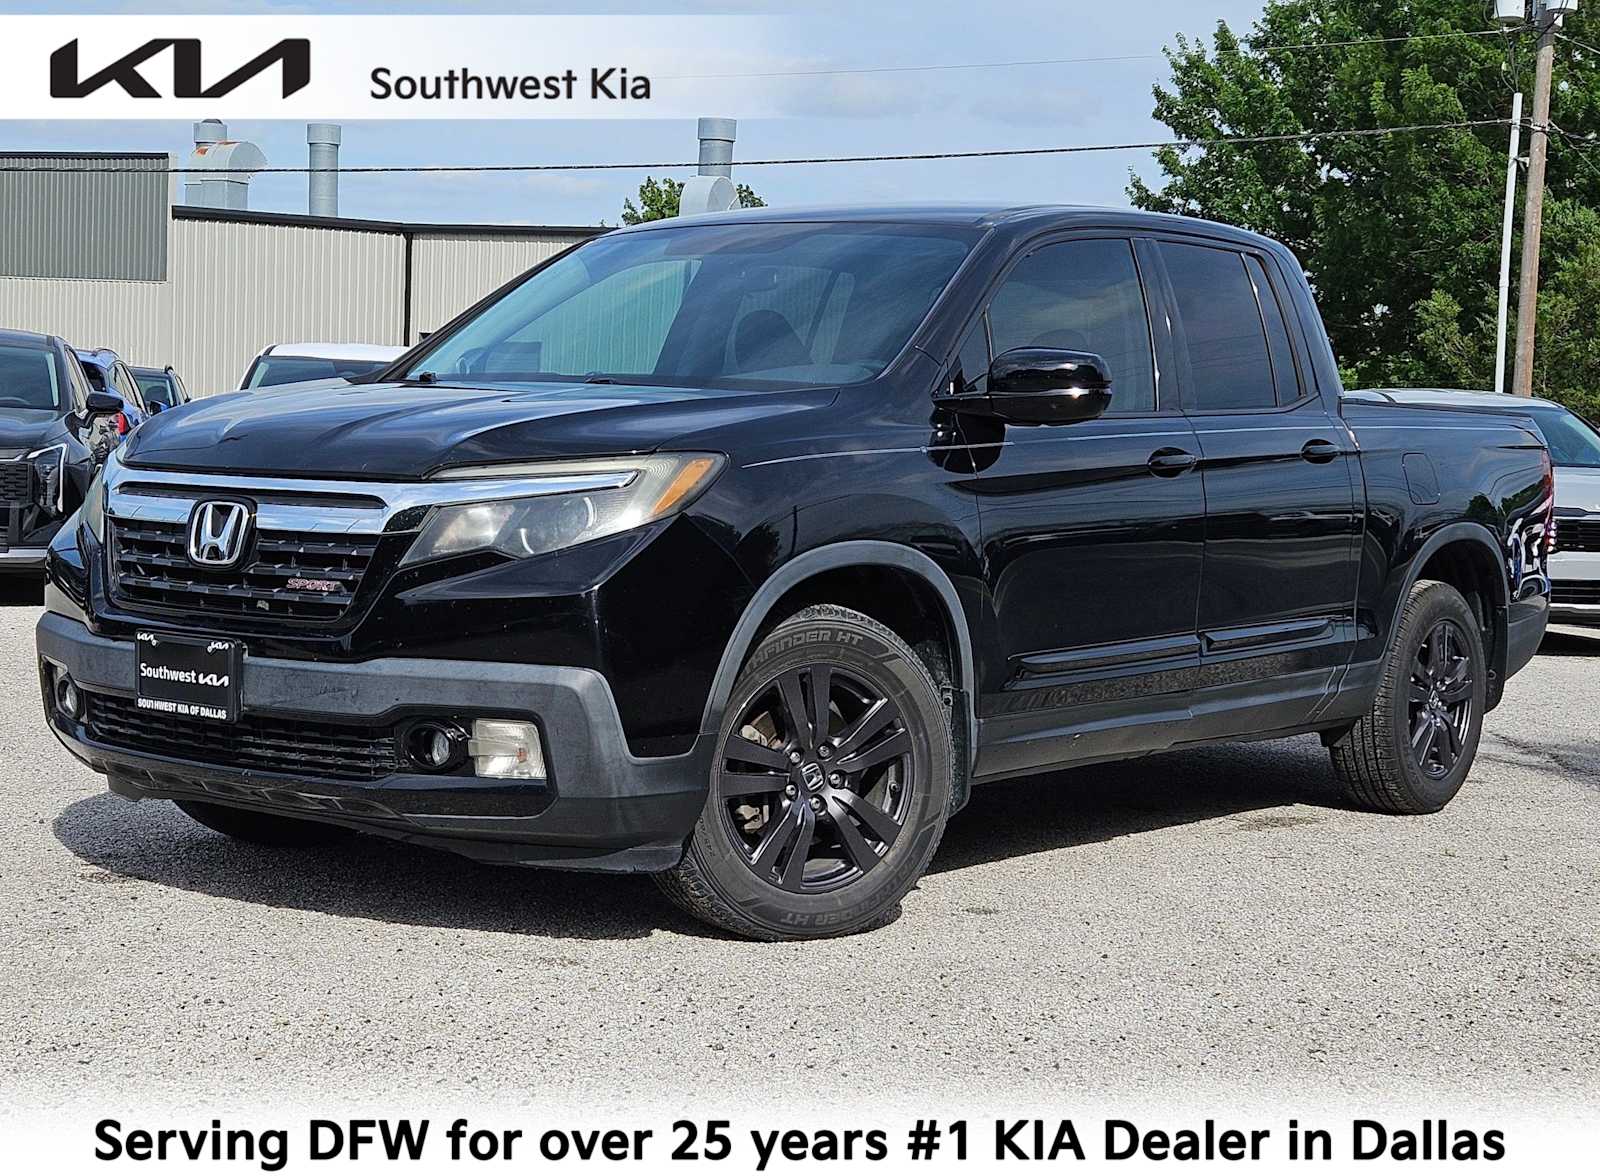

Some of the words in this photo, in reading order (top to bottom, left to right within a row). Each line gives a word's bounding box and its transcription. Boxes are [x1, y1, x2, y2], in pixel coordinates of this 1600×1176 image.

[286, 578, 336, 591] SPORT
[140, 662, 197, 684] Southwest
[137, 698, 177, 713] SOUTHWEST
[177, 704, 189, 716] KIA
[190, 705, 200, 716] OF
[200, 707, 227, 720] DALLAS
